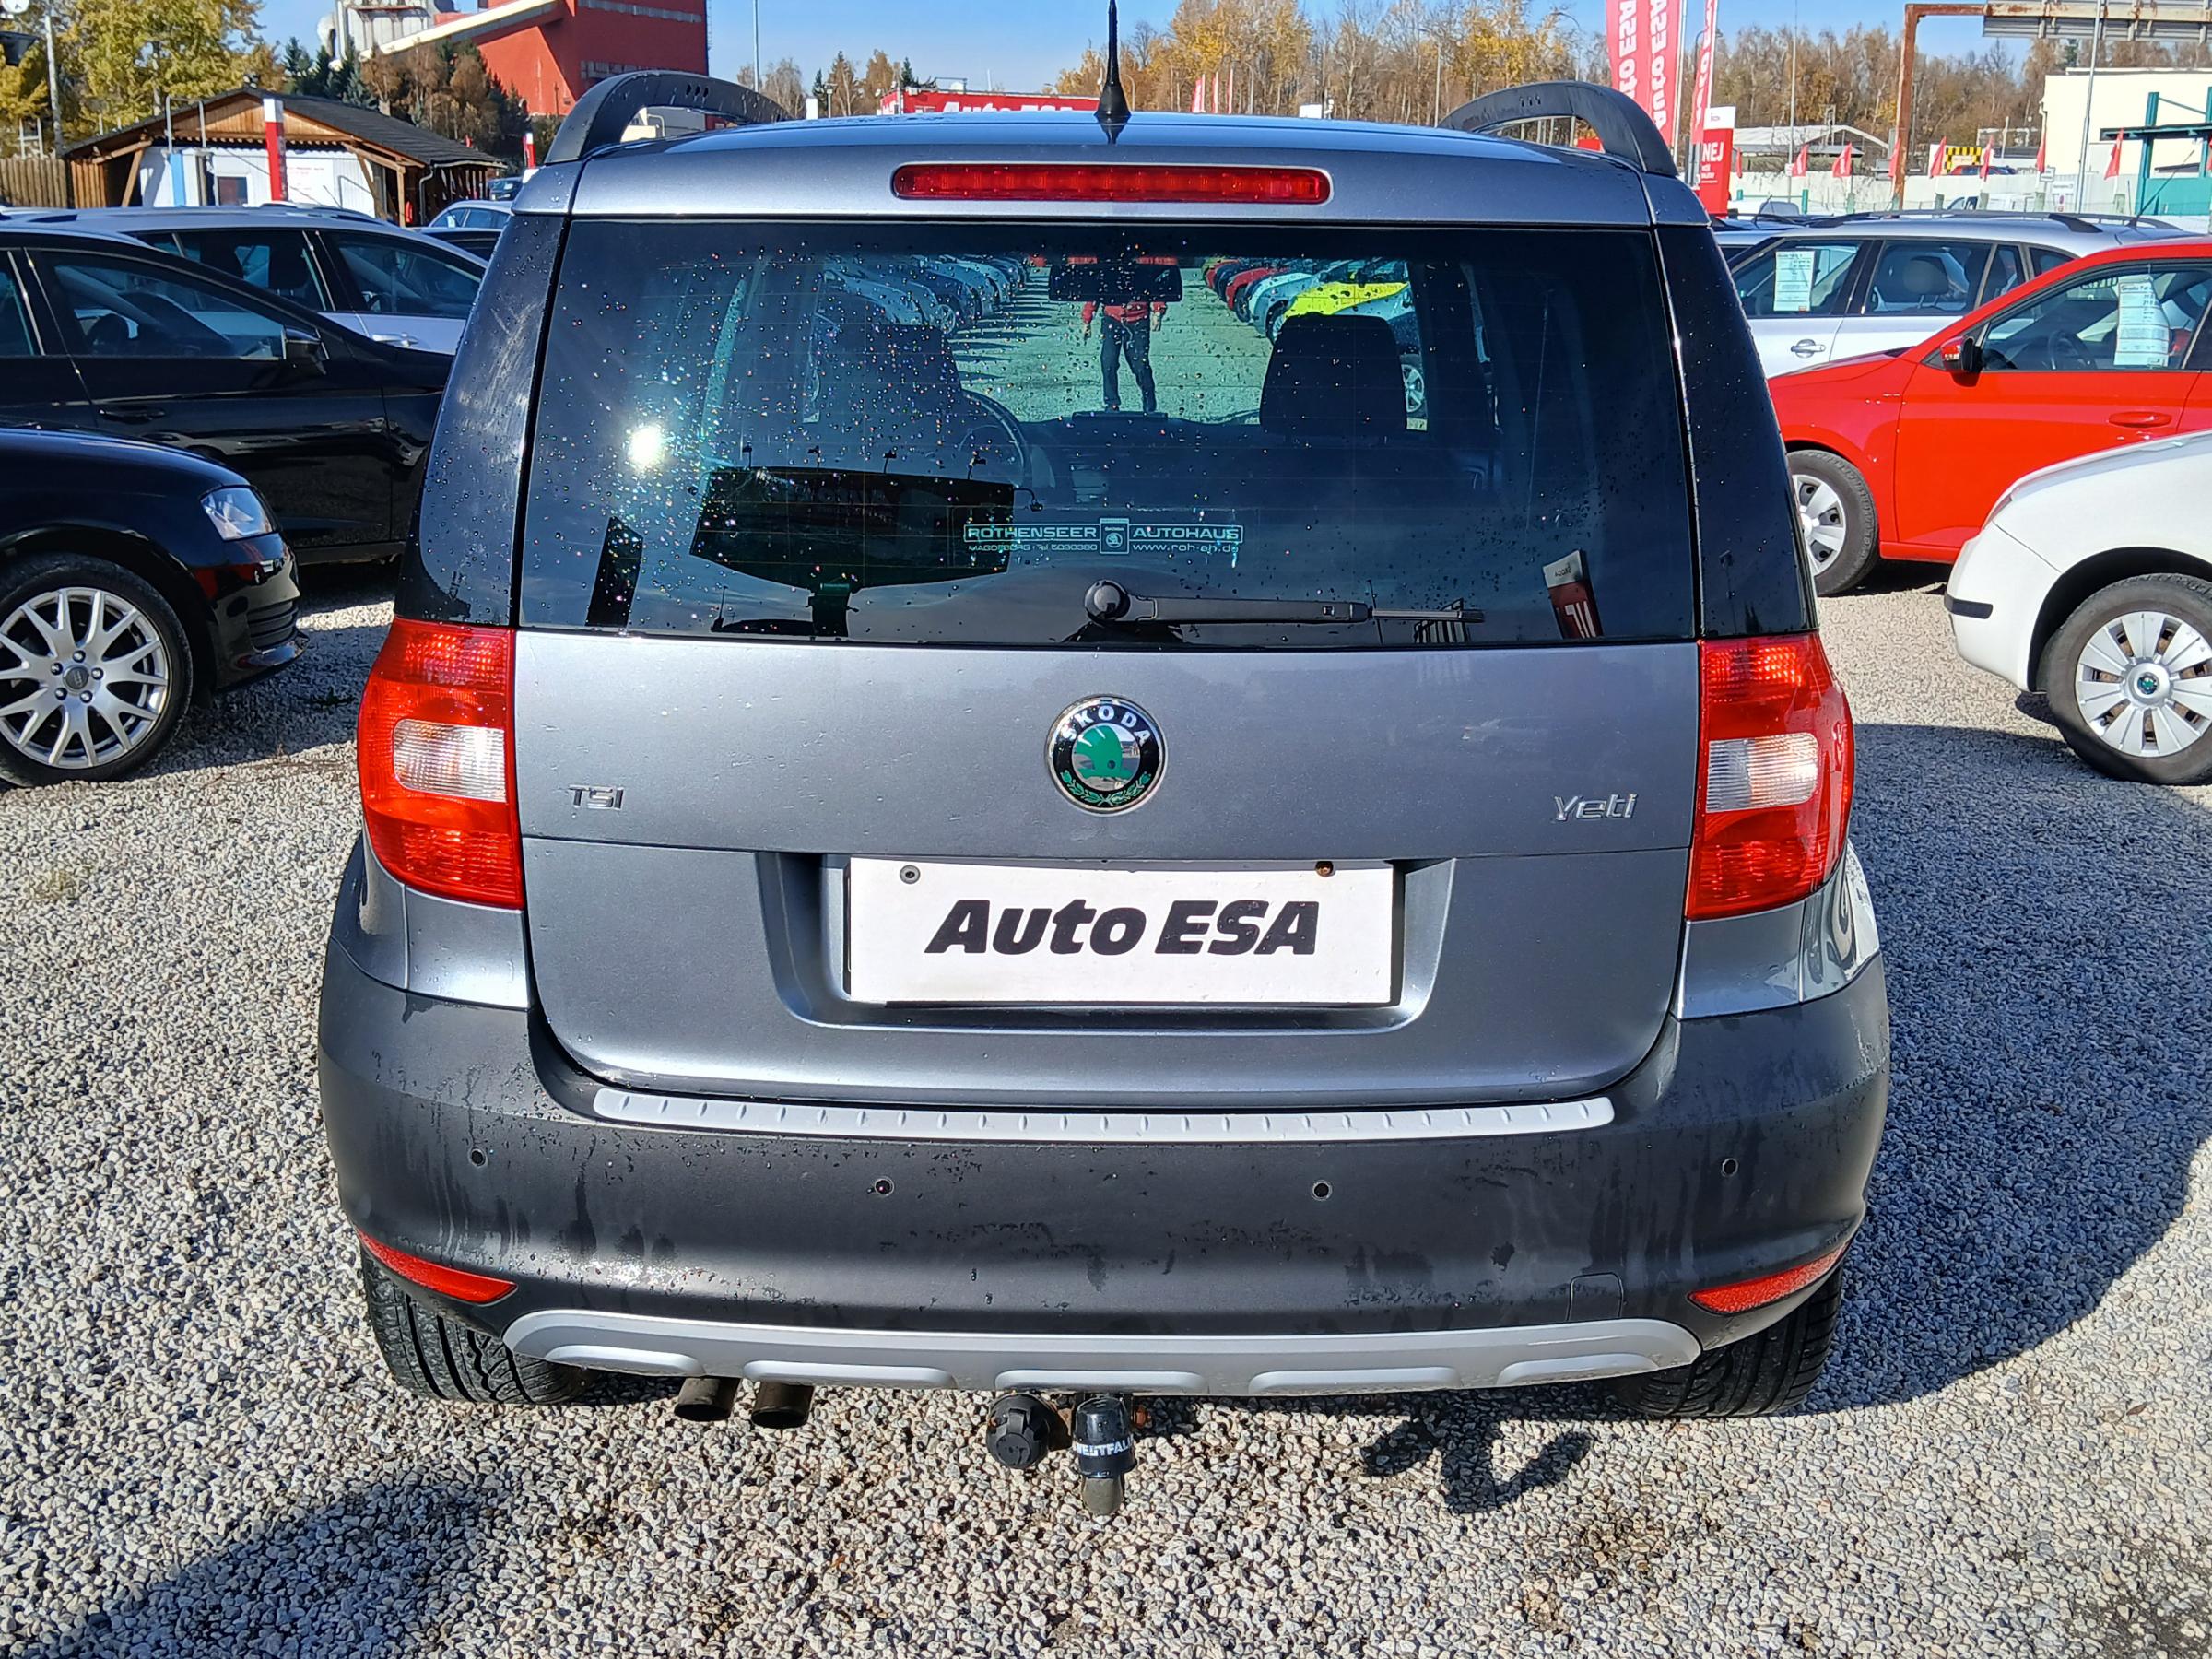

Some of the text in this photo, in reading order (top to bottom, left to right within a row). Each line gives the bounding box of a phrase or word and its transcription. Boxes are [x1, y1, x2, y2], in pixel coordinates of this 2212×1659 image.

[1701, 142, 1724, 162] NEJ
[968, 526, 1097, 539] ROTHENSEER
[1133, 526, 1240, 540] AUTOHAUS
[569, 784, 625, 810] TSI
[1554, 794, 1638, 821] Yeti
[924, 899, 1320, 956] Auto ESA
